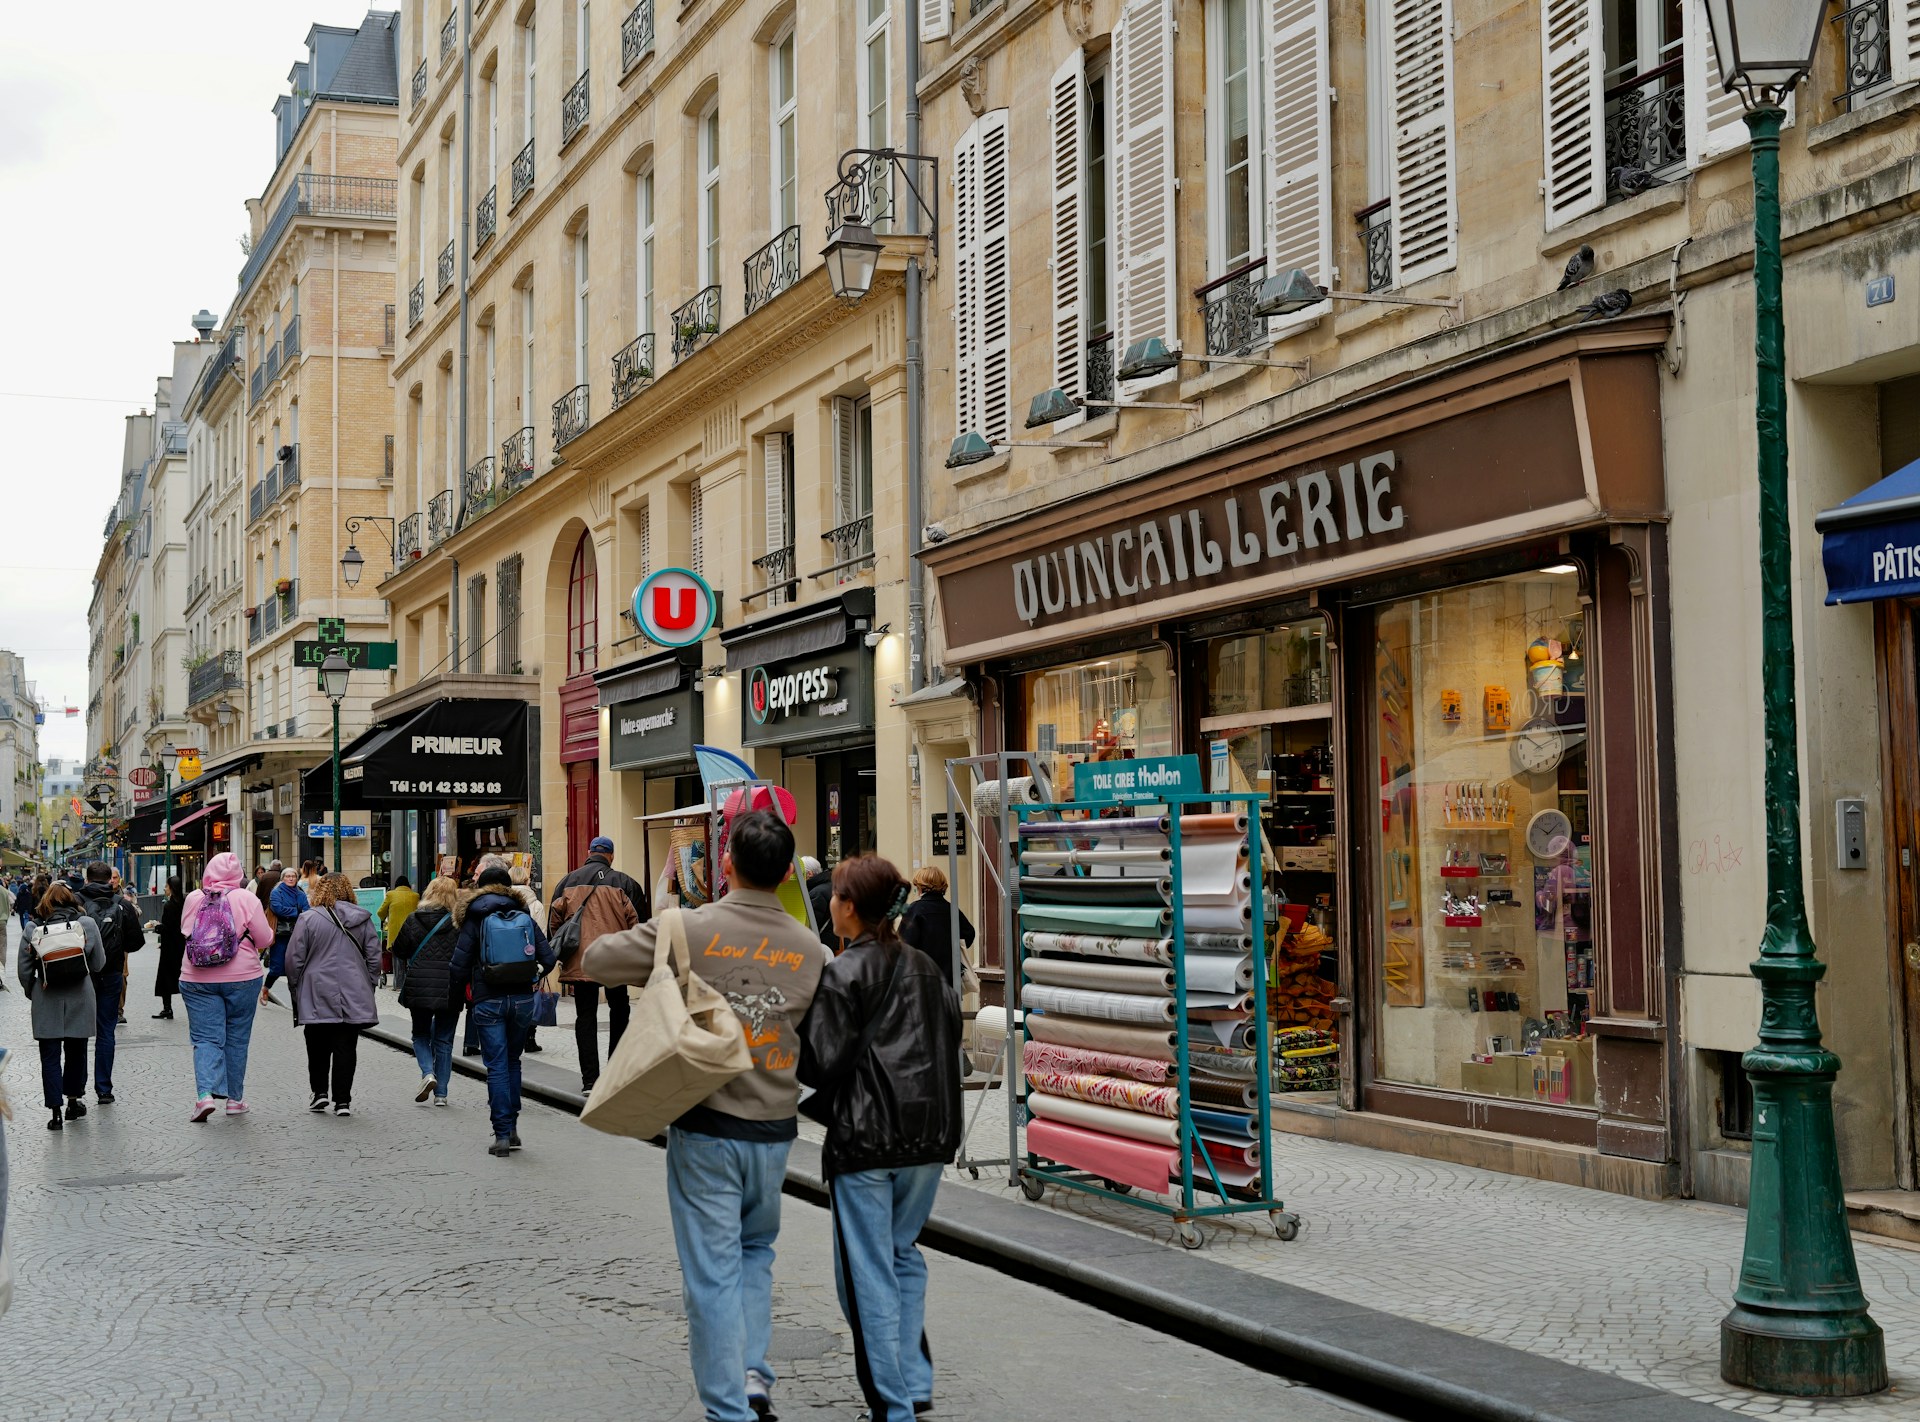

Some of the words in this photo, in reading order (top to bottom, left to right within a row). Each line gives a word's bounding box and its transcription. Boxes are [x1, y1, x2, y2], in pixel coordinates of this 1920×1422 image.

[1871, 281, 1888, 301] 71
[1011, 449, 1404, 627] QUINCAILLERIE
[652, 587, 697, 630] U
[769, 666, 829, 717] express
[620, 718, 636, 736] Votre
[636, 706, 673, 737] supermarché
[411, 736, 503, 755] PRIMEUR
[419, 781, 433, 793] 01
[436, 781, 451, 793] 42
[453, 782, 468, 793] 33
[470, 782, 485, 793] 35
[487, 782, 501, 793] 03
[1093, 774, 1112, 789] TOILE
[1114, 772, 1135, 788] CIREE
[1138, 764, 1181, 787] thollon
[135, 791, 150, 799] BAR
[703, 932, 748, 958] Low
[752, 936, 805, 971] Lying
